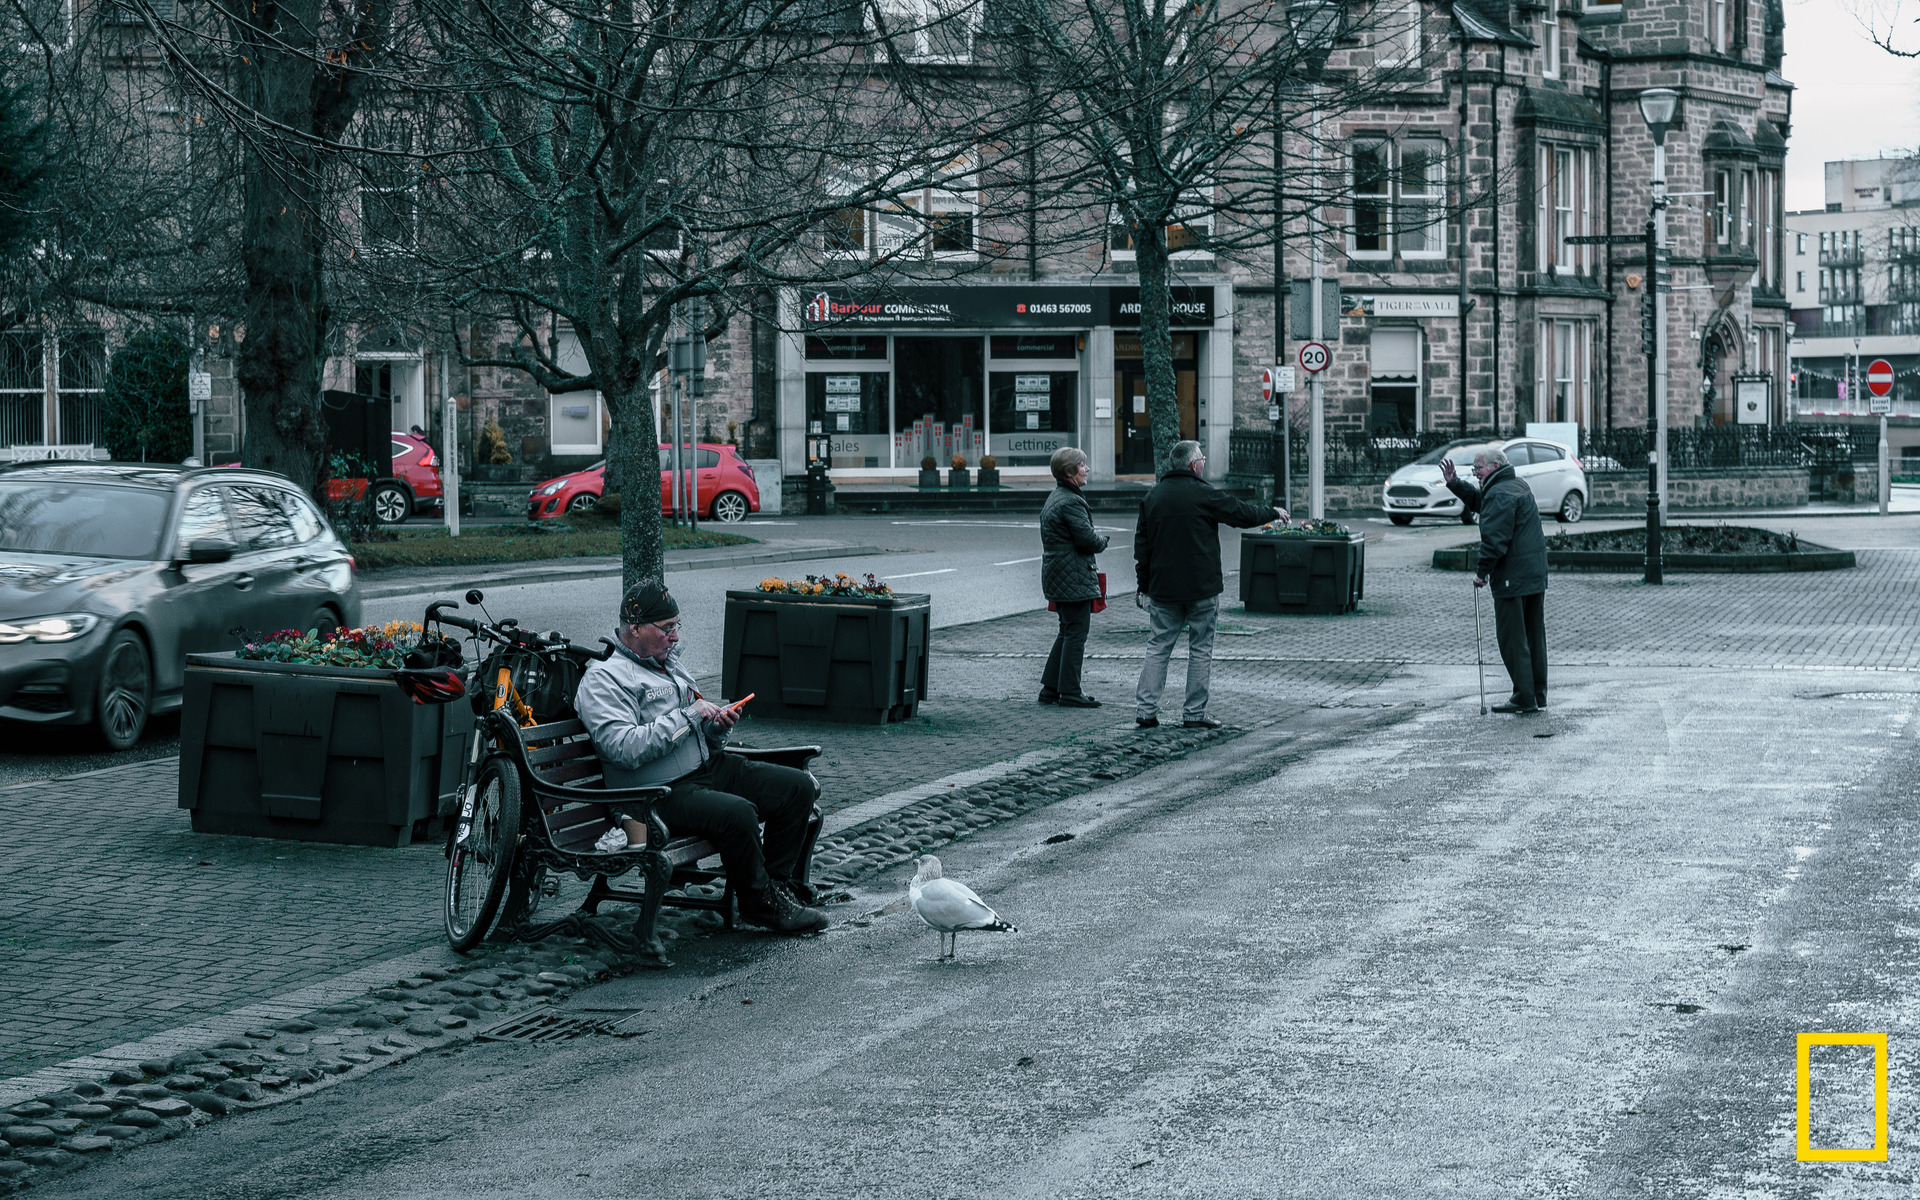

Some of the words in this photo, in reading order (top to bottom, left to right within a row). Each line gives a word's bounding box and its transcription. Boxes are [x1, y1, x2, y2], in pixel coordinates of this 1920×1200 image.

[830, 302, 882, 314] Barbour
[1030, 303, 1058, 314] 01463
[1059, 303, 1092, 314] 567005
[1172, 303, 1206, 314] HOUSE
[1378, 301, 1413, 310] TIGER
[1422, 301, 1454, 310] WALL
[1303, 351, 1325, 364] 20
[1008, 438, 1058, 452] Lettings
[647, 687, 673, 699] cycling
